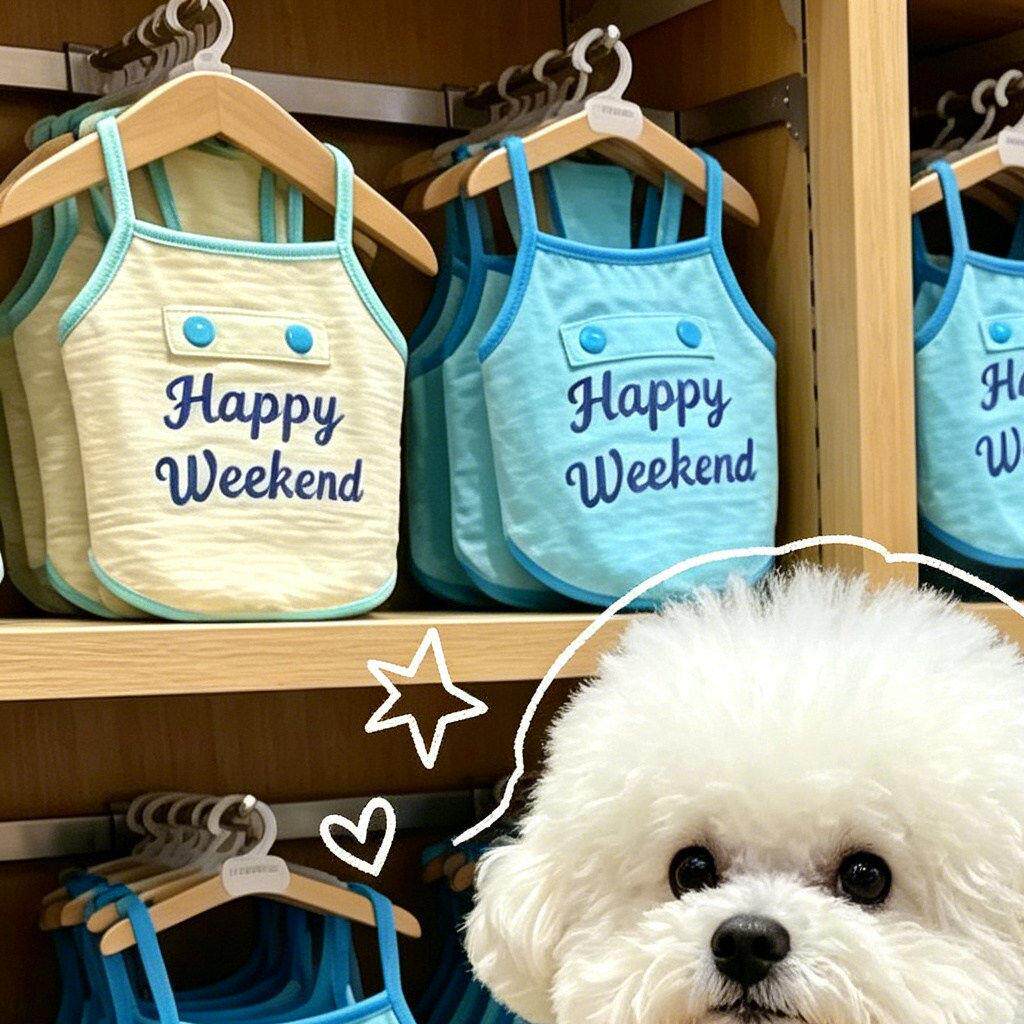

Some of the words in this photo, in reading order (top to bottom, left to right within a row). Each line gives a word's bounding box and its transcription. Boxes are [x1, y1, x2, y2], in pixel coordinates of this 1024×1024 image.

[163, 374, 346, 445] Happy
[566, 370, 732, 434] Happy
[154, 449, 365, 506] Weekend
[565, 437, 757, 509] Weekend
